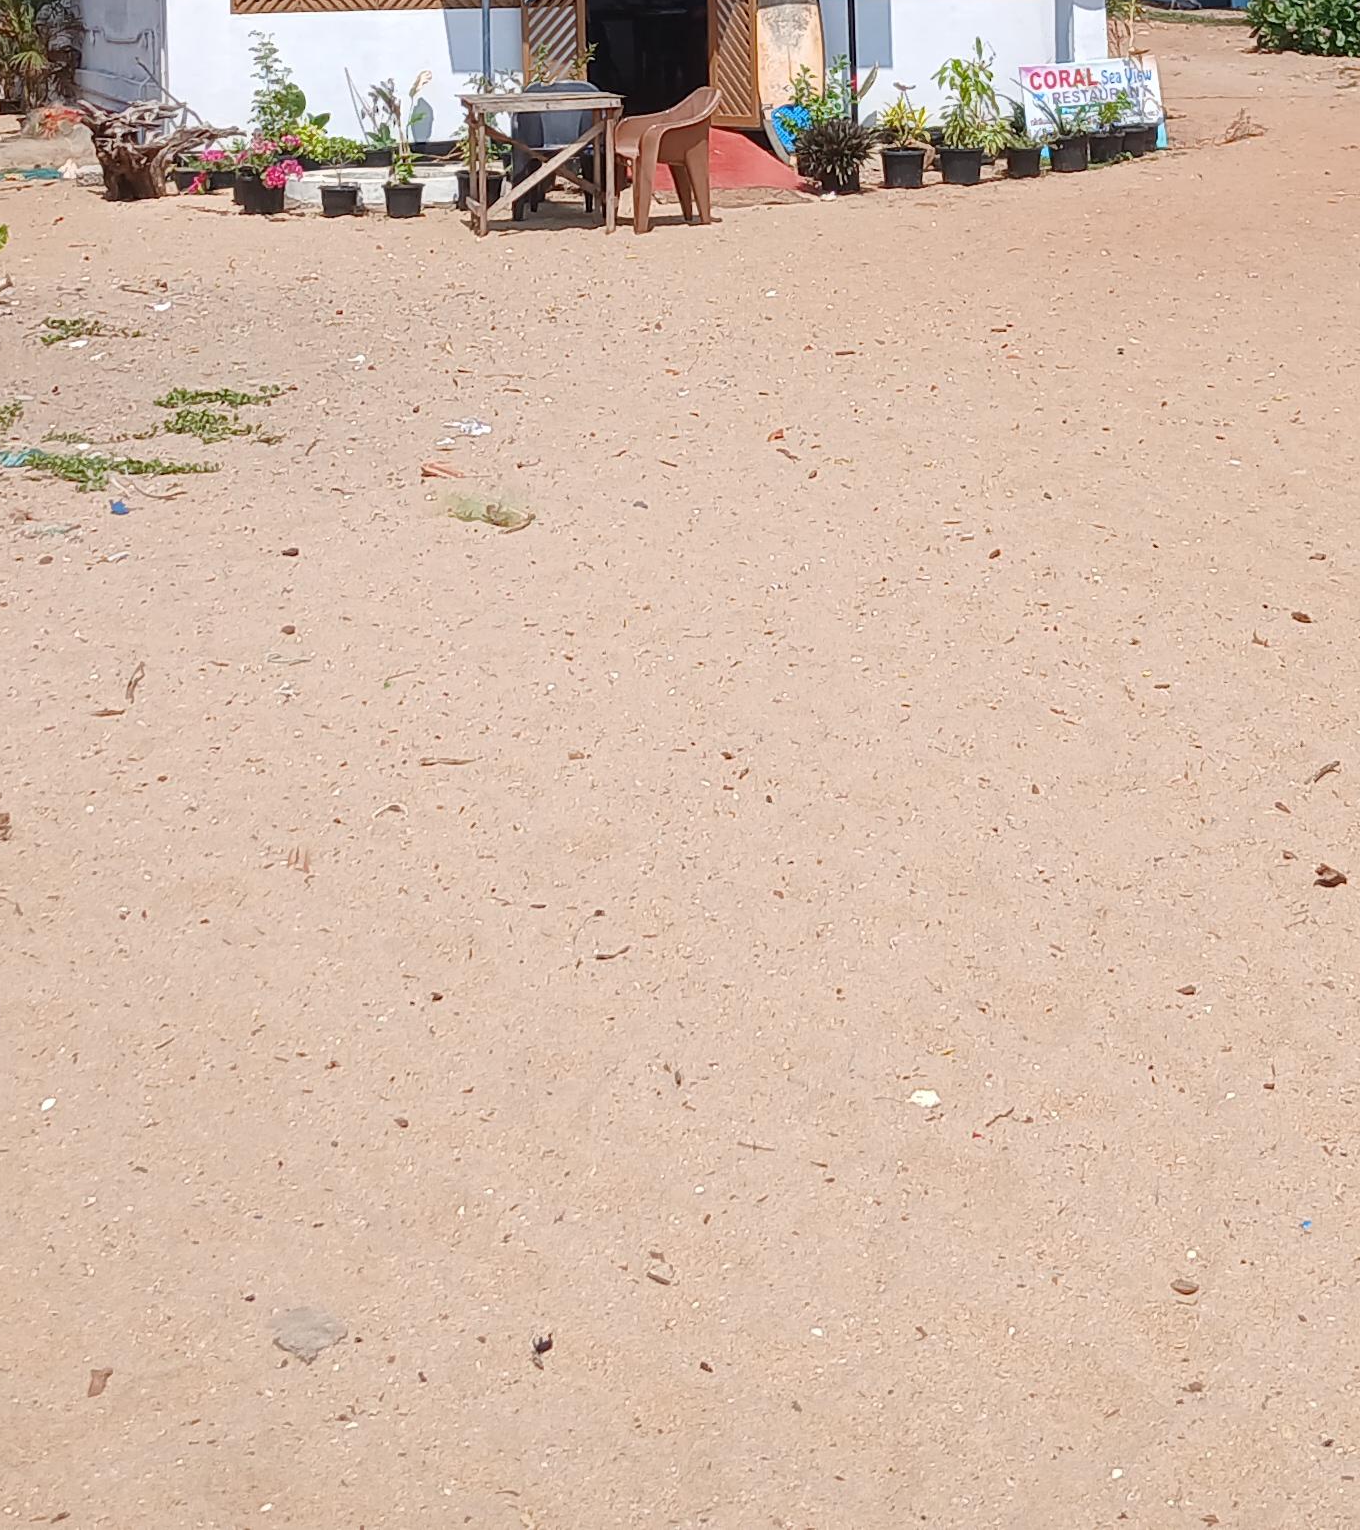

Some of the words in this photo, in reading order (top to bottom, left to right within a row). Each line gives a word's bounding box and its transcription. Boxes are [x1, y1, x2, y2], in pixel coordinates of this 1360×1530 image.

[1029, 68, 1100, 91] CORAL
[1101, 70, 1122, 85] Sea
[1124, 68, 1152, 84] View
